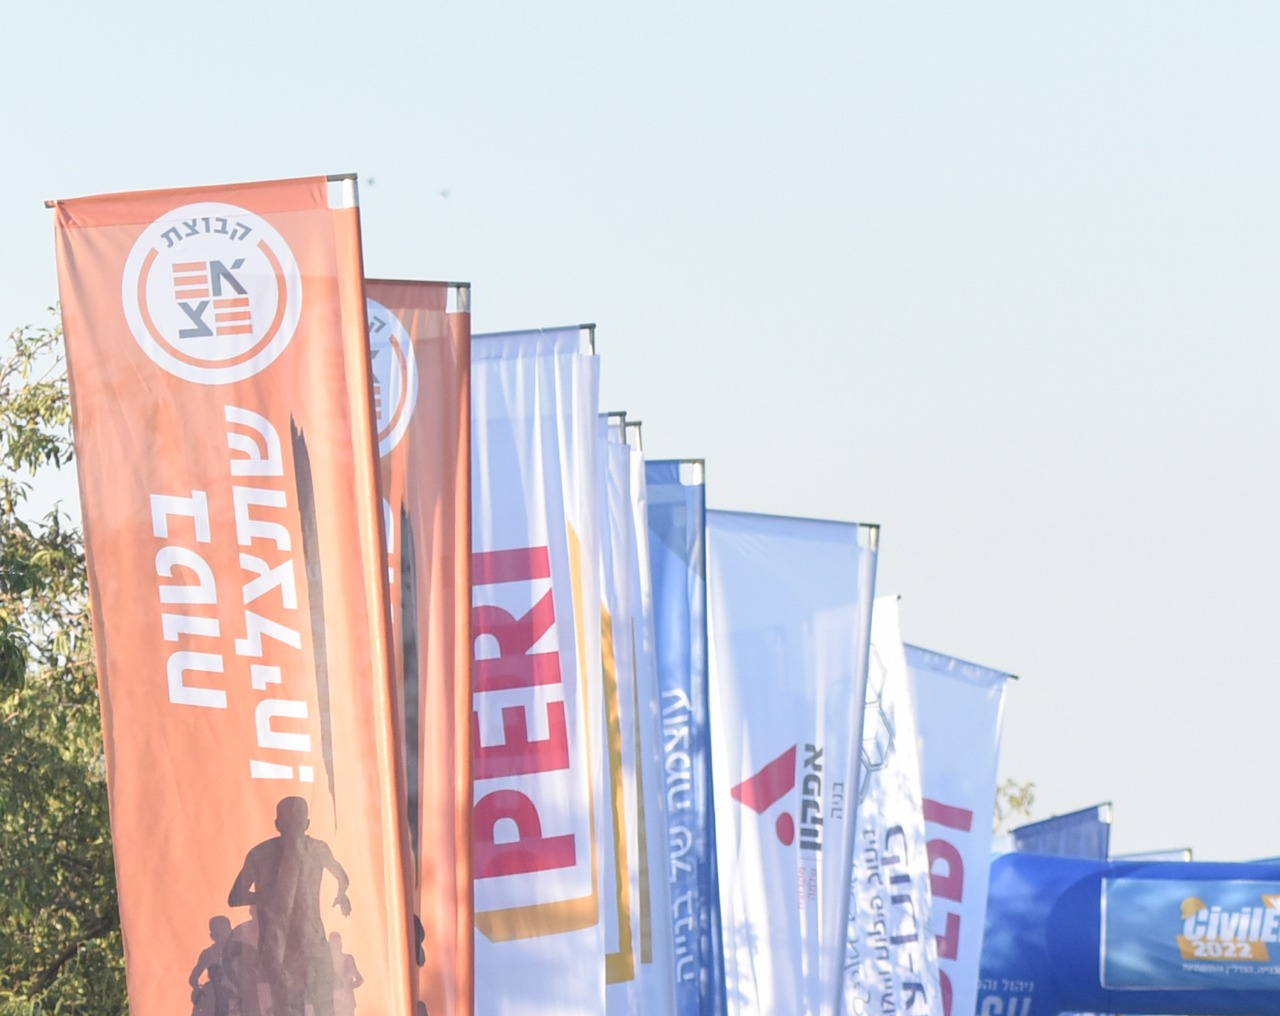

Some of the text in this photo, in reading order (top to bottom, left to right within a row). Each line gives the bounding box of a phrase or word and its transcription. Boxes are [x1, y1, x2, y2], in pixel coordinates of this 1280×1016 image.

[160, 217, 252, 248] קבוצת
[149, 490, 227, 709] בטוח
[224, 404, 314, 783] שתצליח!
[472, 545, 577, 880] PERI
[800, 744, 823, 851] אפקון
[830, 782, 844, 820] בניה
[668, 826, 693, 884] של
[1192, 942, 1253, 958] 2022
